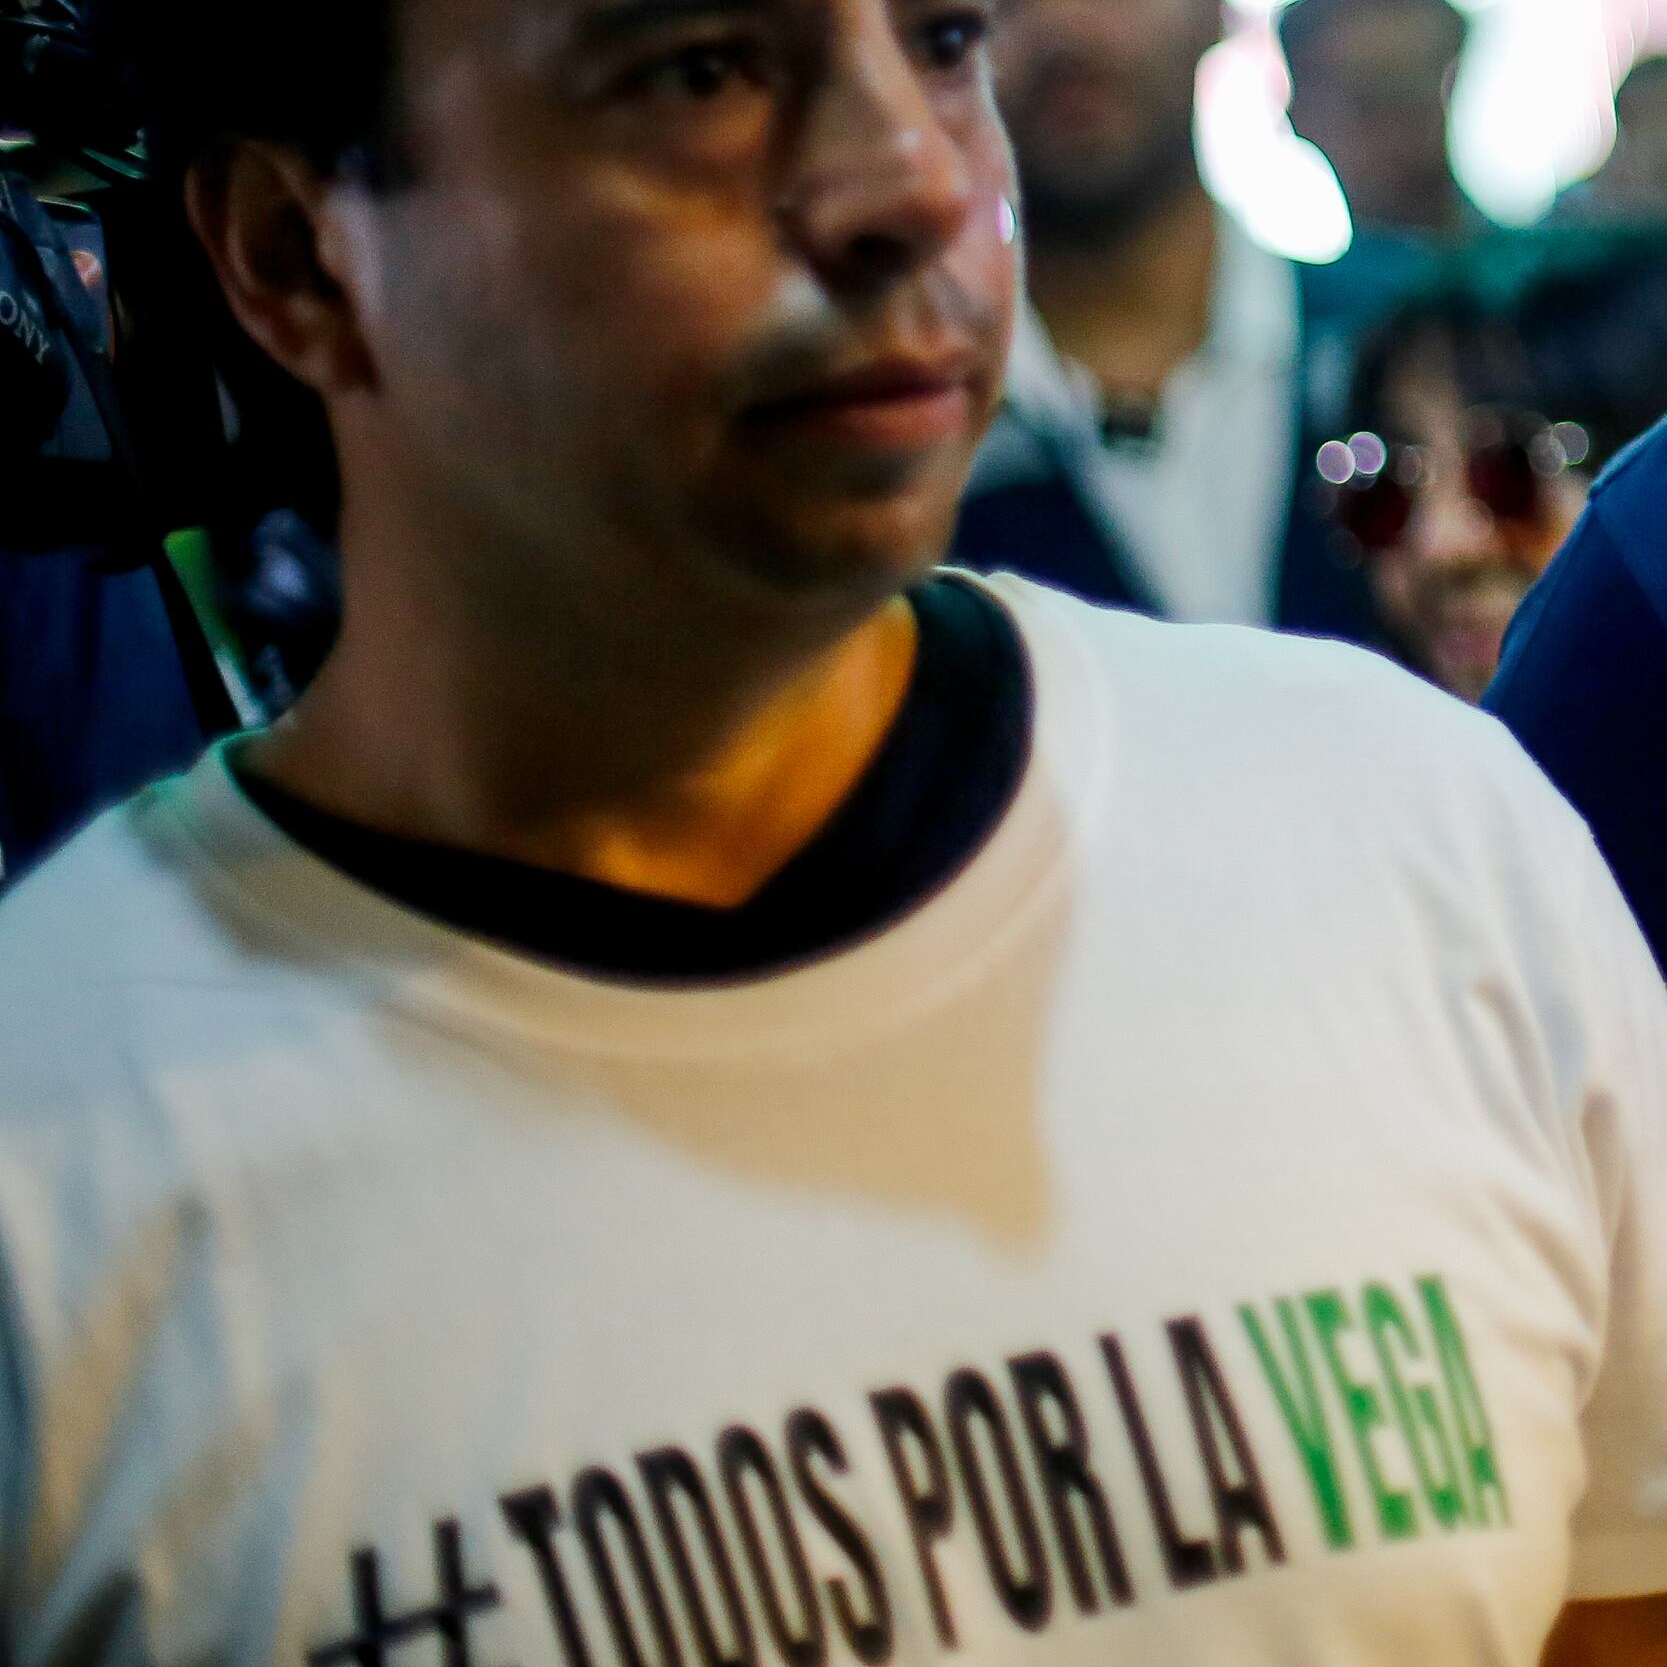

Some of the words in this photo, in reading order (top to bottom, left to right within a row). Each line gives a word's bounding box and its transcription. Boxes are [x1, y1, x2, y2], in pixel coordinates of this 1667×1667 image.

[0, 290, 51, 367] ONY
[867, 1348, 1136, 1652] POR
[1097, 1313, 1288, 1592] LA
[1235, 1273, 1514, 1552] VEGA
